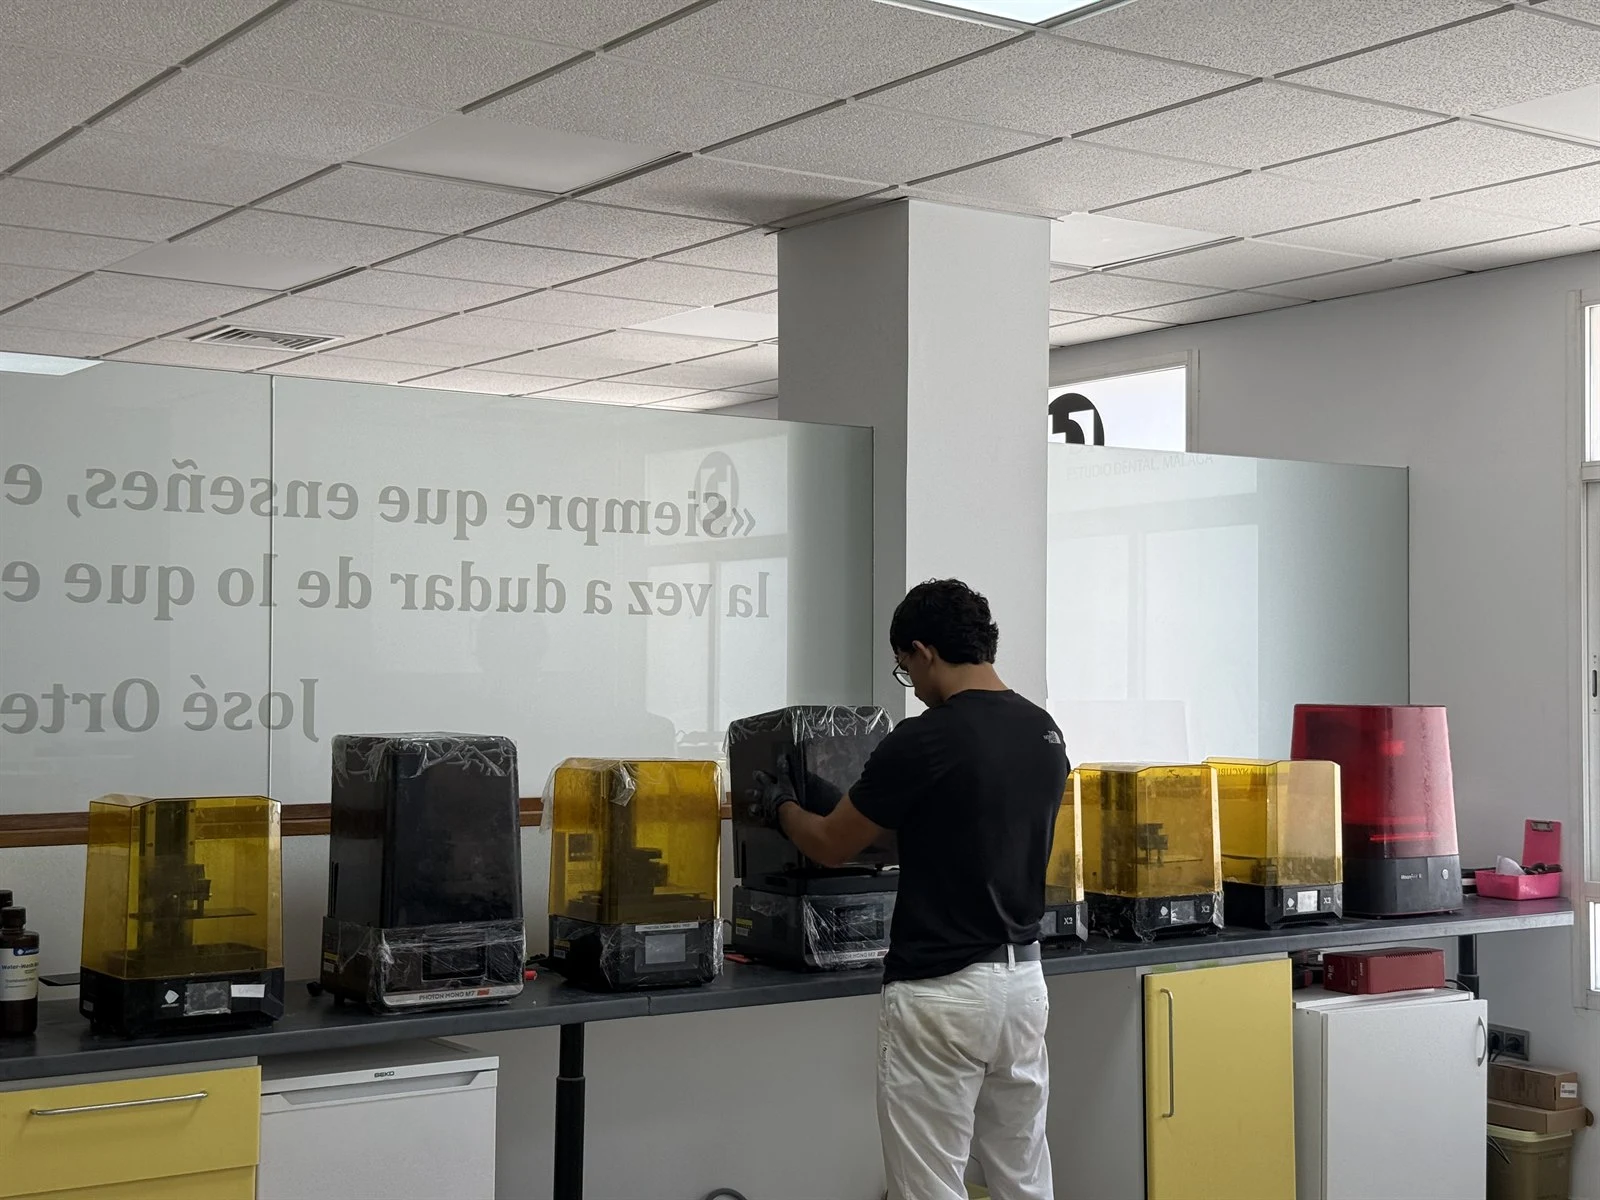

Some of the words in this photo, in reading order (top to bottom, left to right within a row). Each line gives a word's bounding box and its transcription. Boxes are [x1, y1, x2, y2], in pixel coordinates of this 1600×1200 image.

[1323, 897, 1332, 905] X2
[1201, 905, 1210, 913] X2
[1063, 916, 1073, 925] X2
[418, 993, 445, 1001] PHOTON
[445, 991, 464, 999] MONO
[465, 990, 476, 998] M7
[374, 1070, 395, 1078] BEKO
